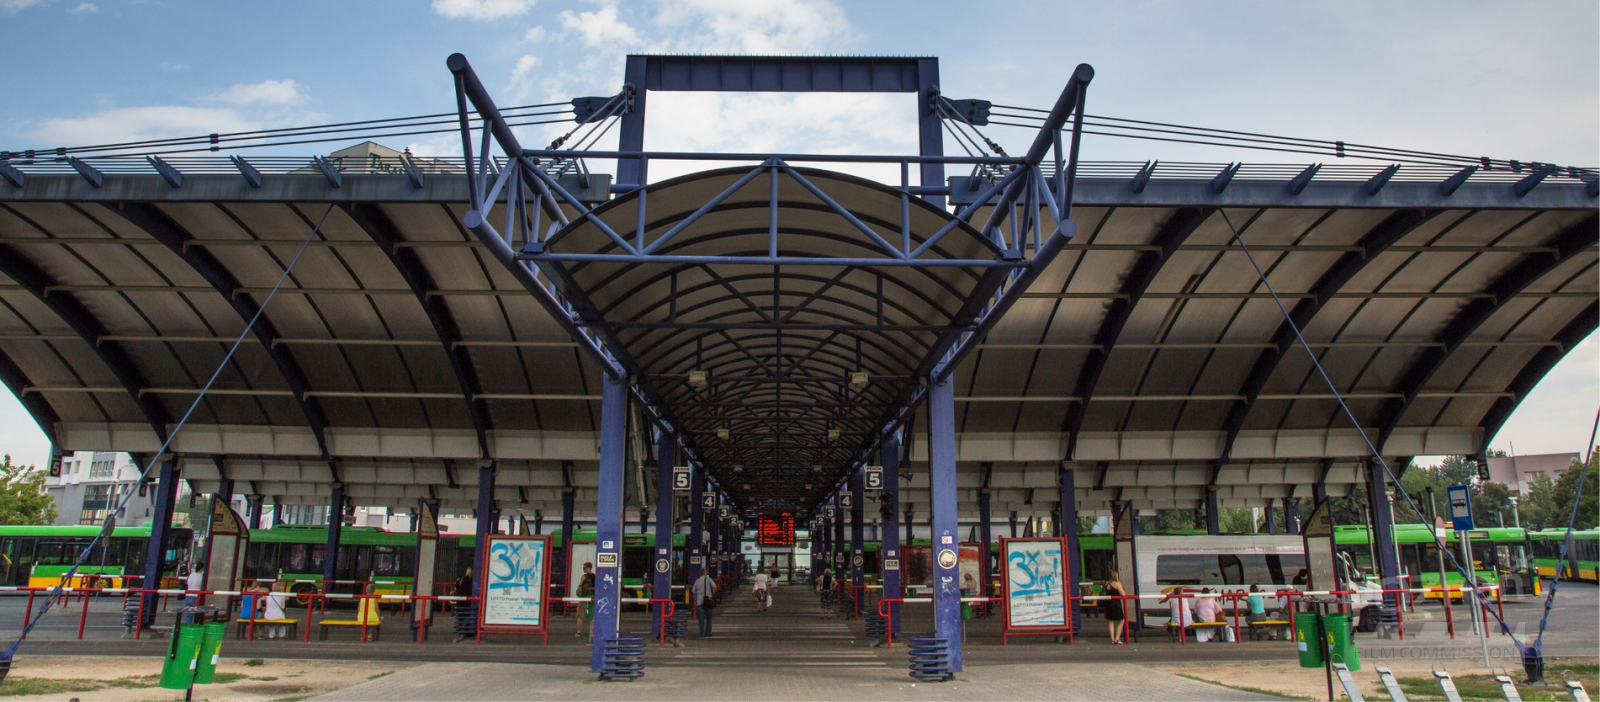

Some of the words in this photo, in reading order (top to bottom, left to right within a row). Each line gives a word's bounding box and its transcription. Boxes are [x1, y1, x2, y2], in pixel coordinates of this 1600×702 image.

[53, 462, 60, 475] 5
[1480, 465, 1488, 478] 5
[677, 474, 688, 487] 5
[869, 473, 880, 487] 5
[704, 497, 713, 507] 4
[842, 496, 850, 506] 4
[721, 509, 727, 517] 3
[828, 509, 834, 517] 3
